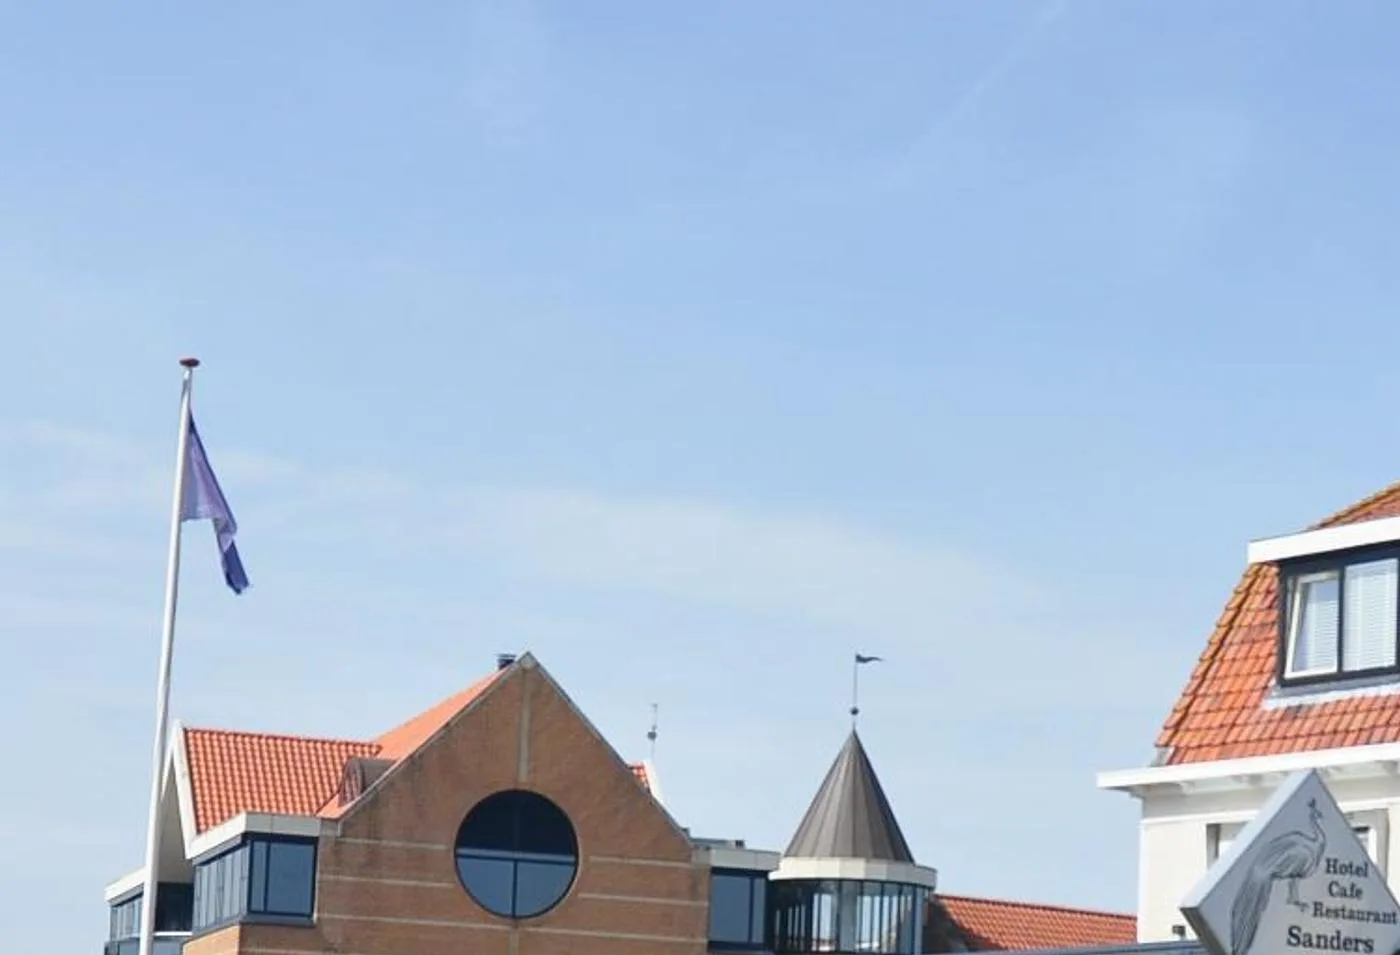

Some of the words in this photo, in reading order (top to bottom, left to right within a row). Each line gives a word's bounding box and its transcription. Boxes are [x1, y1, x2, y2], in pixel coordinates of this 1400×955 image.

[1325, 858, 1369, 877] Hotel
[1328, 880, 1363, 900] Cafe
[1312, 901, 1398, 924] Restaurant
[1286, 925, 1375, 954] Sanders
